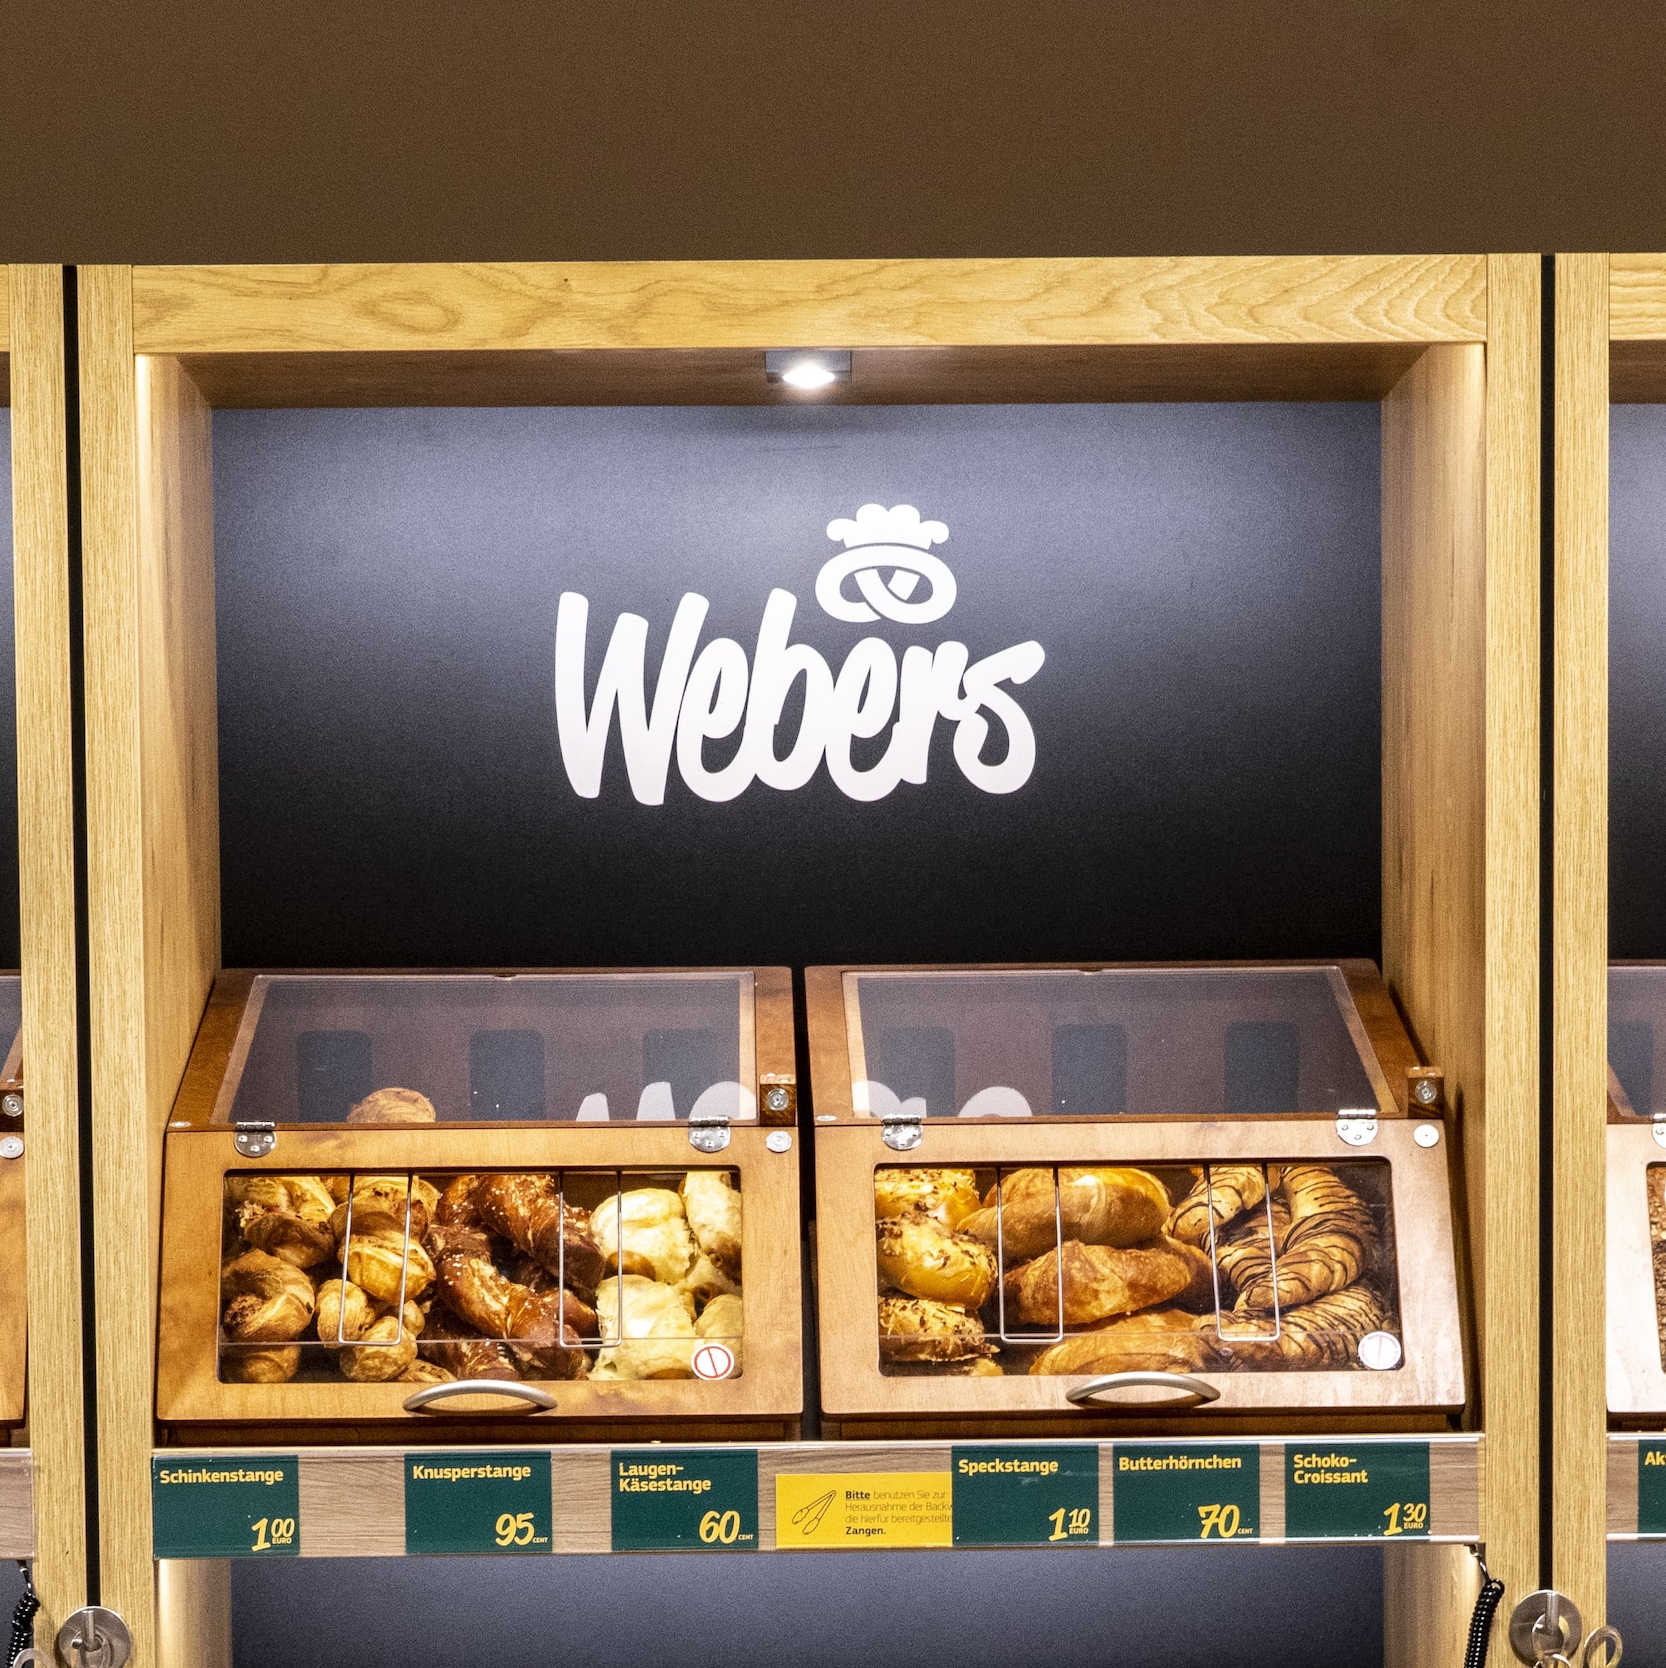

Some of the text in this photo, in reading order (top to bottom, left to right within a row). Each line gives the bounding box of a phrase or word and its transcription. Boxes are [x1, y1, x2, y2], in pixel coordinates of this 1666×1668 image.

[554, 587, 1046, 806] Webers
[959, 1458, 1058, 1476] Speckstange
[1119, 1455, 1241, 1470] Butterhörnchen
[1294, 1453, 1357, 1468] Schoko-
[160, 1469, 283, 1485] Schinkenstange
[413, 1465, 531, 1482] Knusperstange
[620, 1463, 683, 1479] Laugen-
[1294, 1469, 1368, 1483] Croissant
[620, 1476, 711, 1494] Käsestange
[845, 1489, 946, 1500] Bitte benutzen Sie zur
[845, 1501, 923, 1511] Herausnahme der
[845, 1513, 889, 1523] die hierfür
[1197, 1504, 1240, 1539] 70
[496, 1512, 536, 1546] 95
[699, 1511, 741, 1543] 60
[845, 1526, 886, 1537] Zangen.
